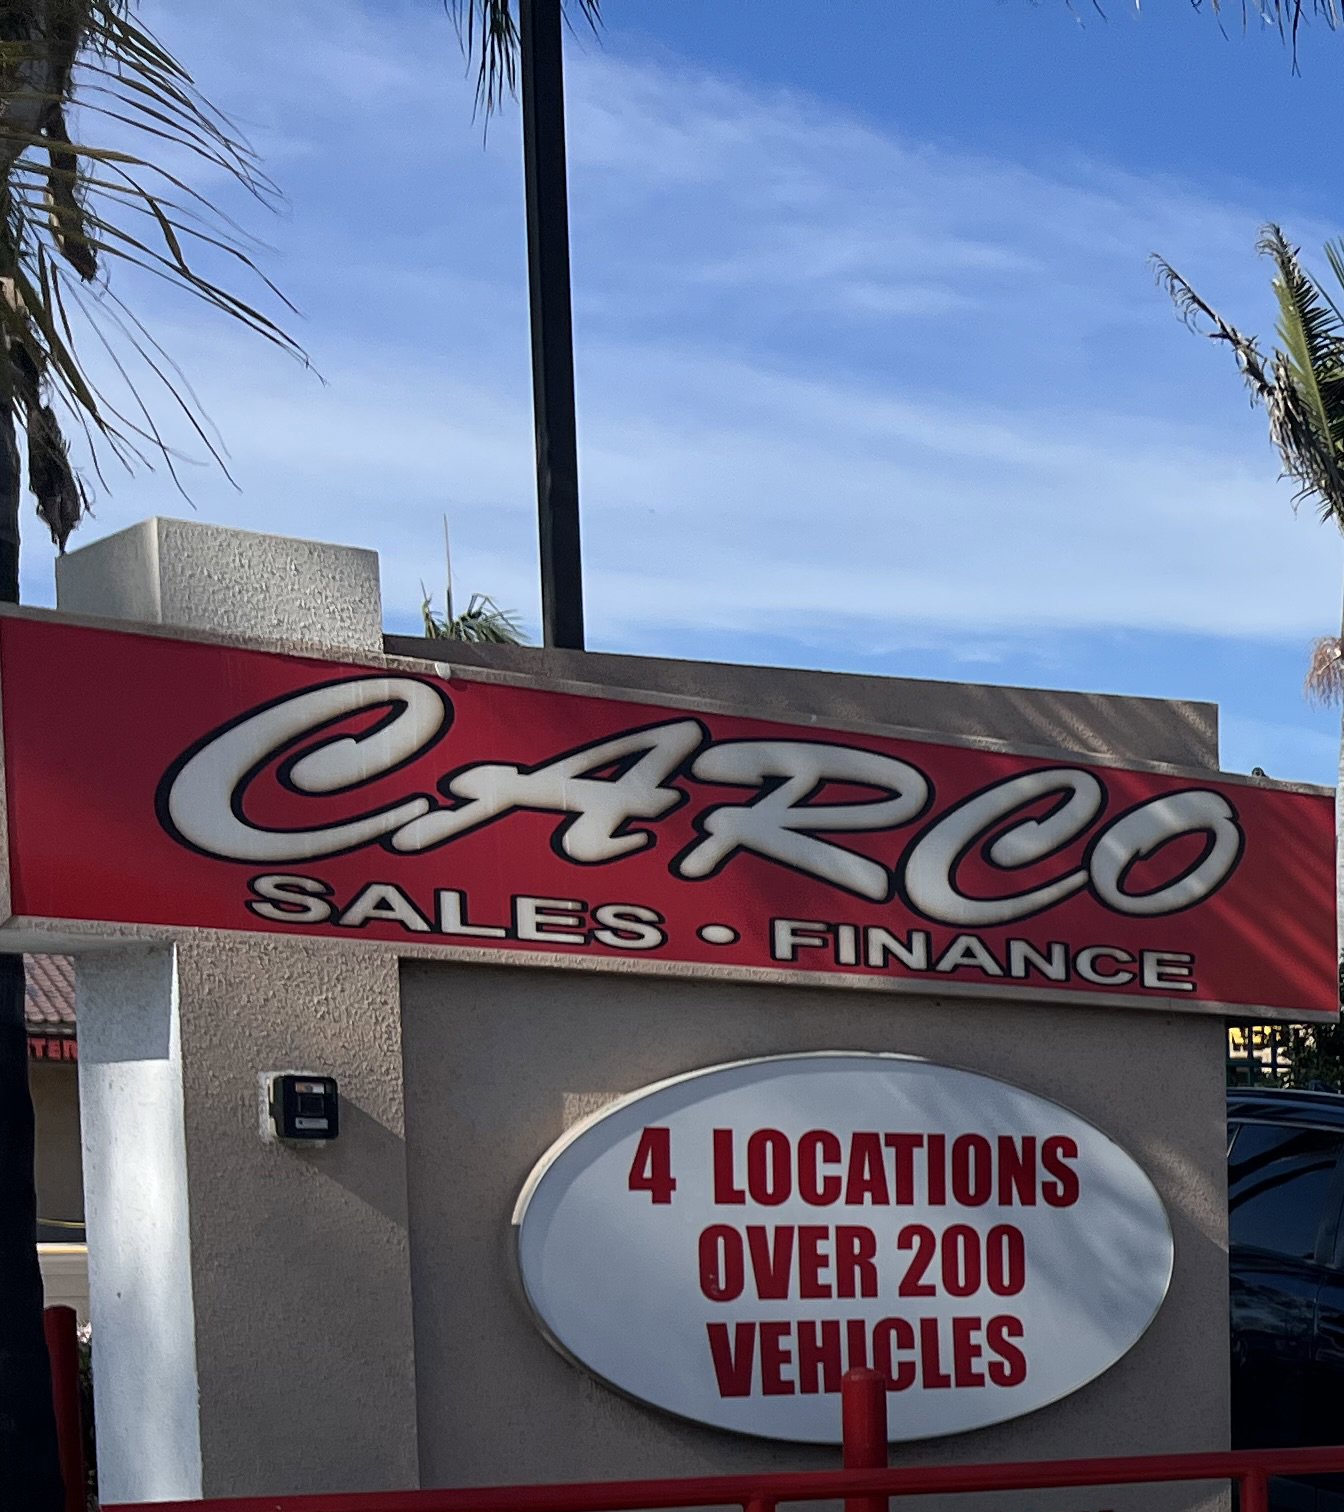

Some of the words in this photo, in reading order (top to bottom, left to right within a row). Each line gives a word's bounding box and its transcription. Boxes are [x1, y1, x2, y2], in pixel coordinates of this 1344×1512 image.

[158, 674, 1243, 928] CARCO
[247, 873, 666, 950] SALES
[769, 917, 1198, 993] FINANCE
[627, 1126, 677, 1206] 4
[712, 1128, 1080, 1209] LOCATIONS
[698, 1223, 879, 1303] OVER
[896, 1223, 1026, 1299] 200
[705, 1313, 1028, 1399] VEHICLES
